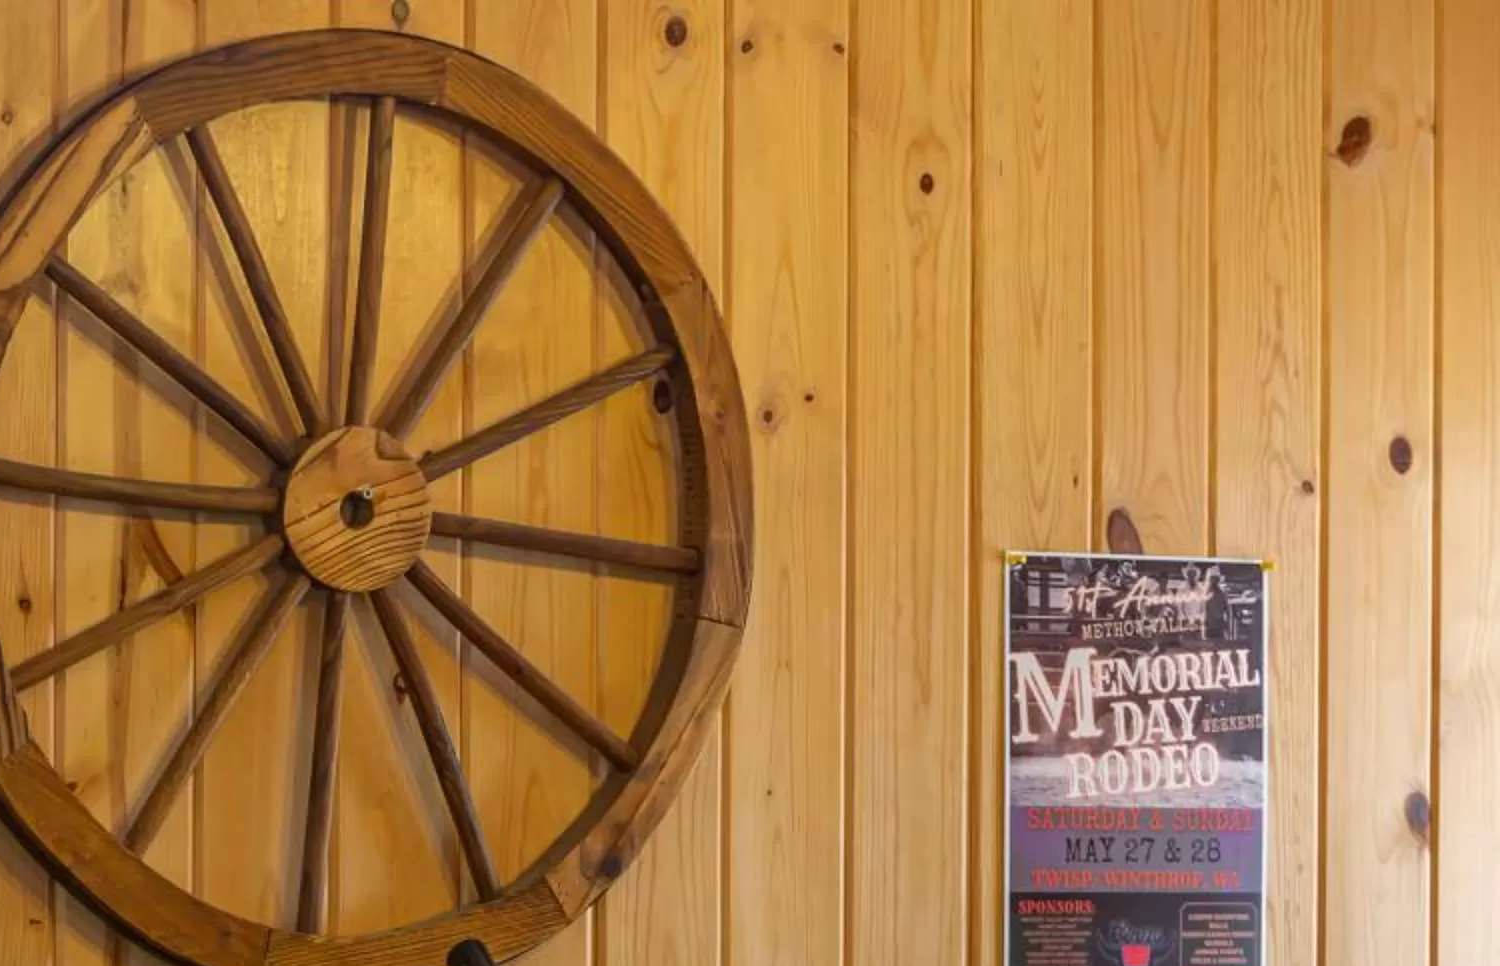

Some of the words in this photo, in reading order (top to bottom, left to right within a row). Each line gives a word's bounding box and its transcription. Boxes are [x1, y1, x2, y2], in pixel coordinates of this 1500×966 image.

[1010, 647, 1261, 745] MEMORIAL
[1110, 696, 1202, 748] DAY
[1064, 742, 1220, 799] RODEO
[1027, 807, 1141, 833] SATURDAY
[1172, 808, 1254, 833] SUNDAY
[1065, 836, 1116, 865] MAY
[1124, 836, 1156, 864] 27
[1163, 838, 1182, 864] &
[1190, 837, 1222, 864] 28
[1018, 899, 1094, 914] SPONSORS
